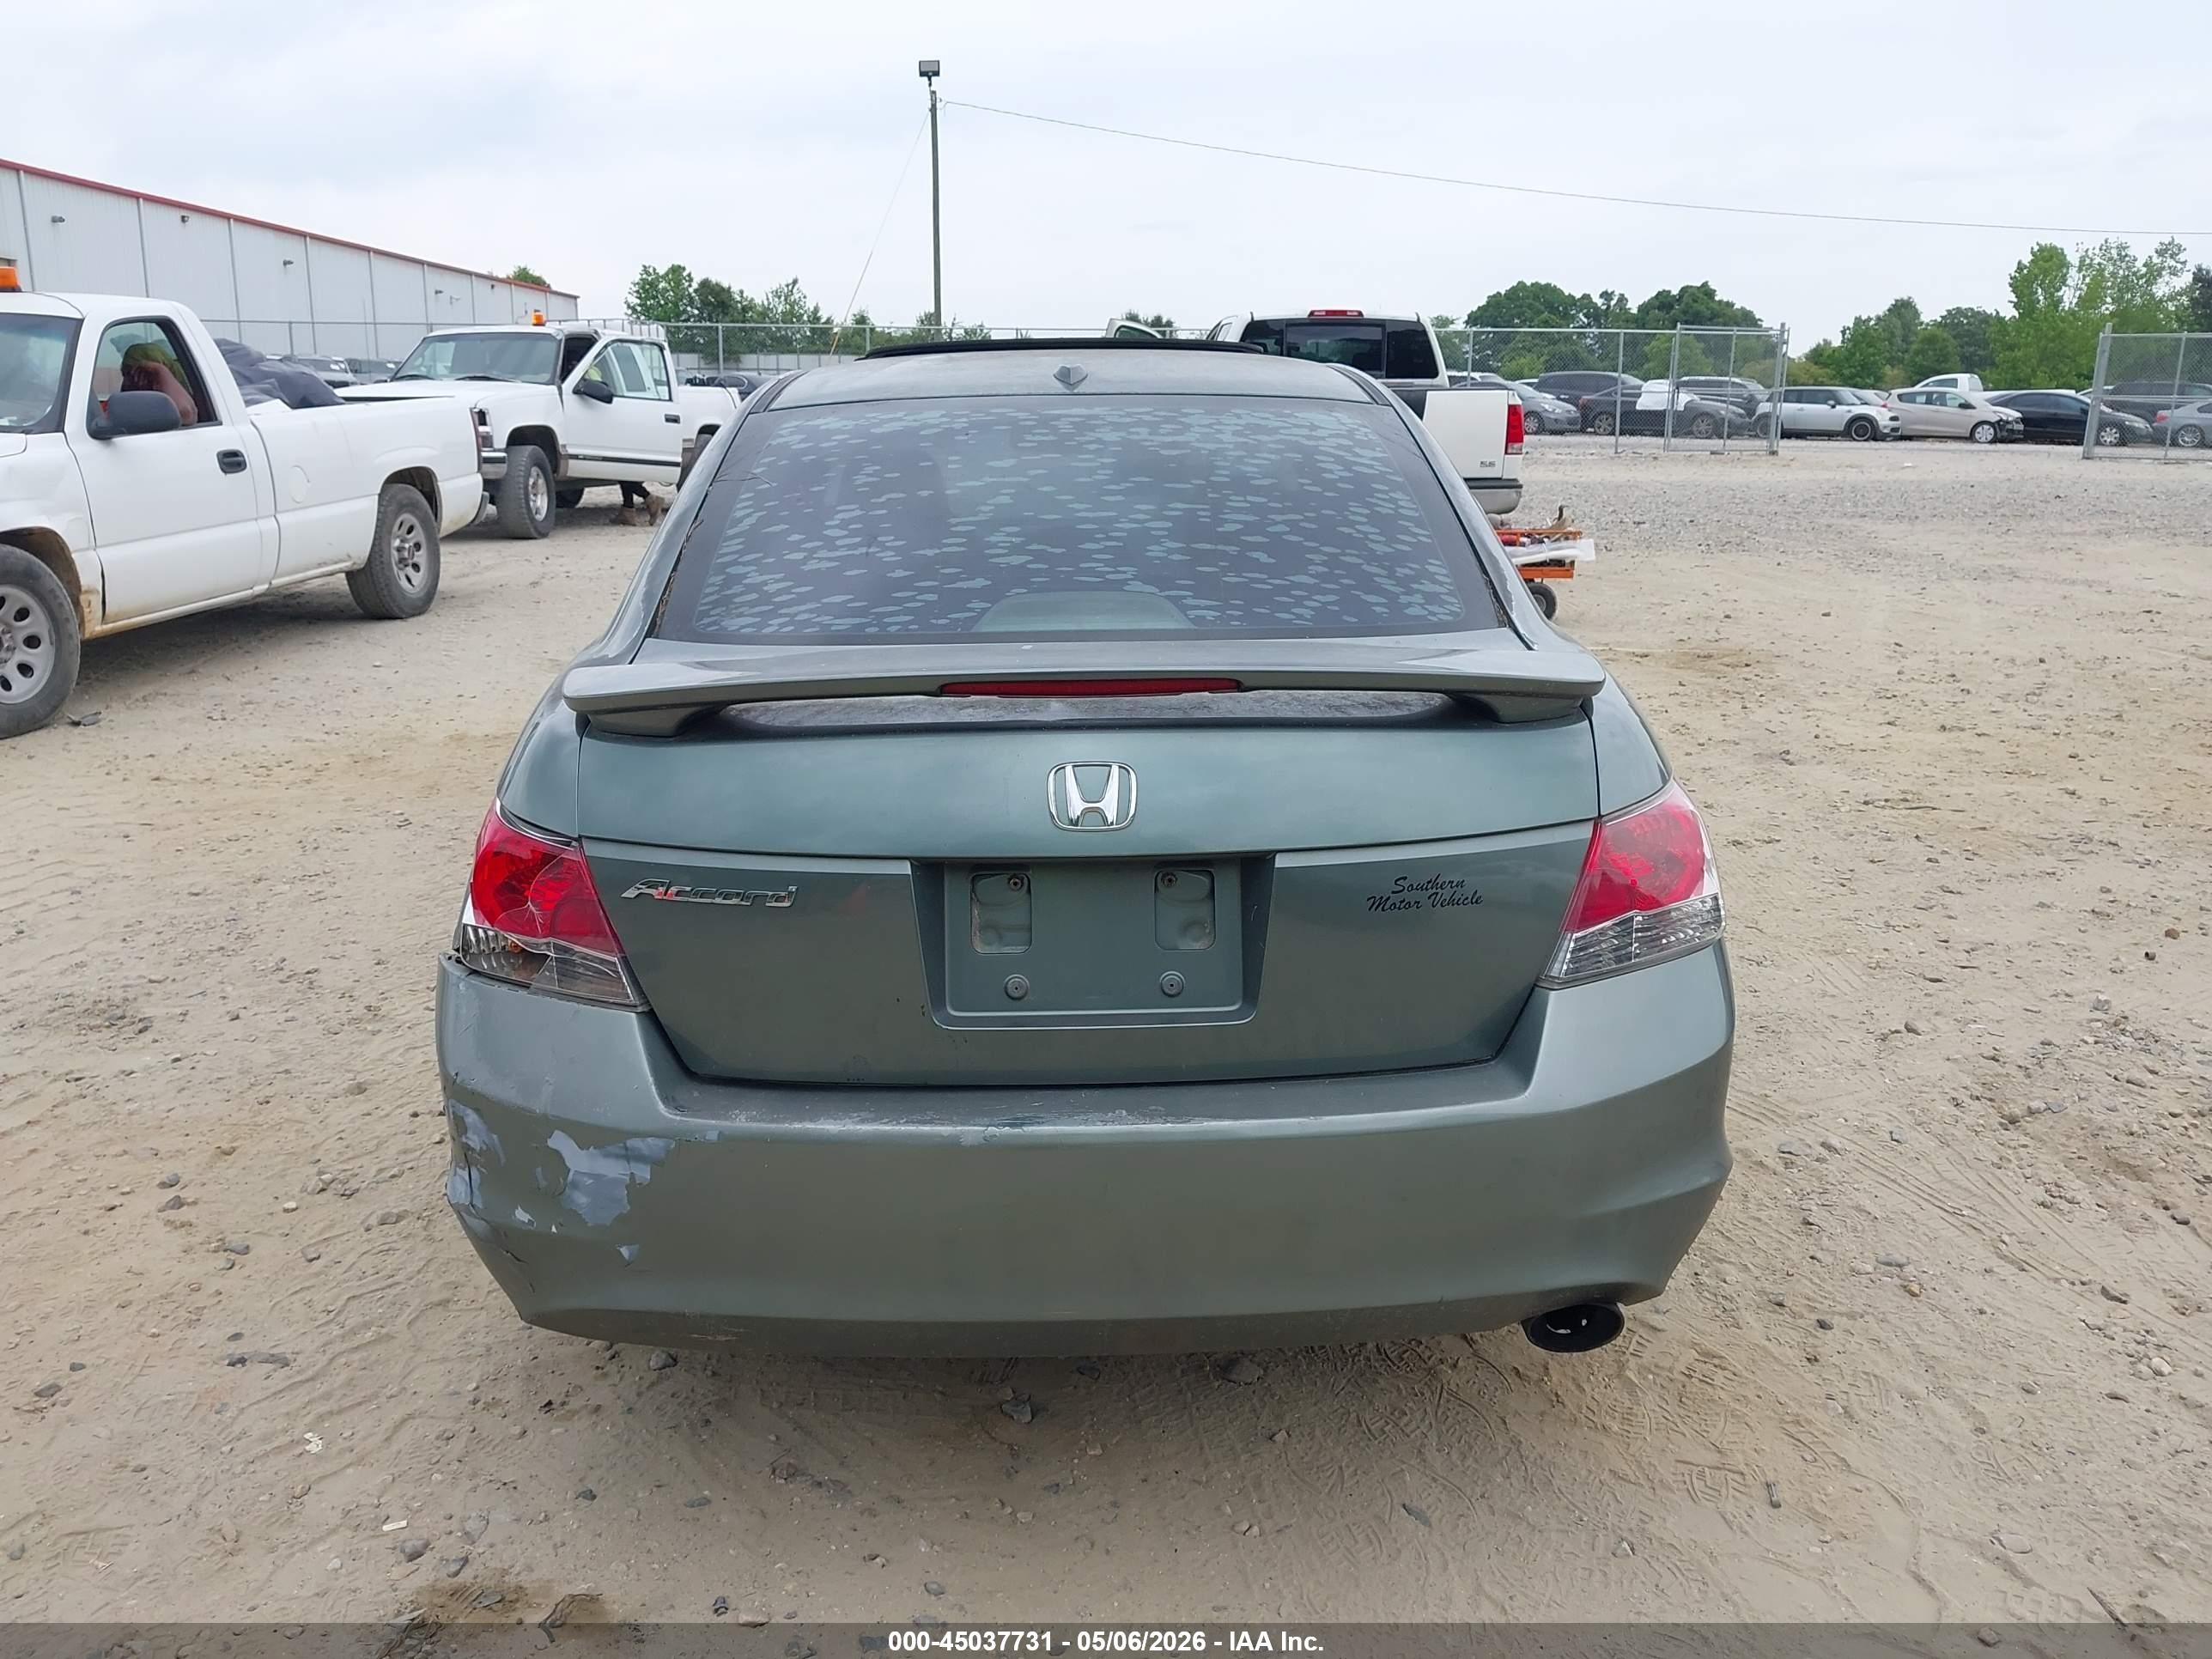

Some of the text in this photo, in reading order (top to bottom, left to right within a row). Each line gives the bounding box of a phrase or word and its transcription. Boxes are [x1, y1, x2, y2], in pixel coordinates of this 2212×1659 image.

[620, 878, 798, 907] Accord
[1391, 872, 1465, 894] Southern
[1366, 890, 1483, 912] Motor Vehicle
